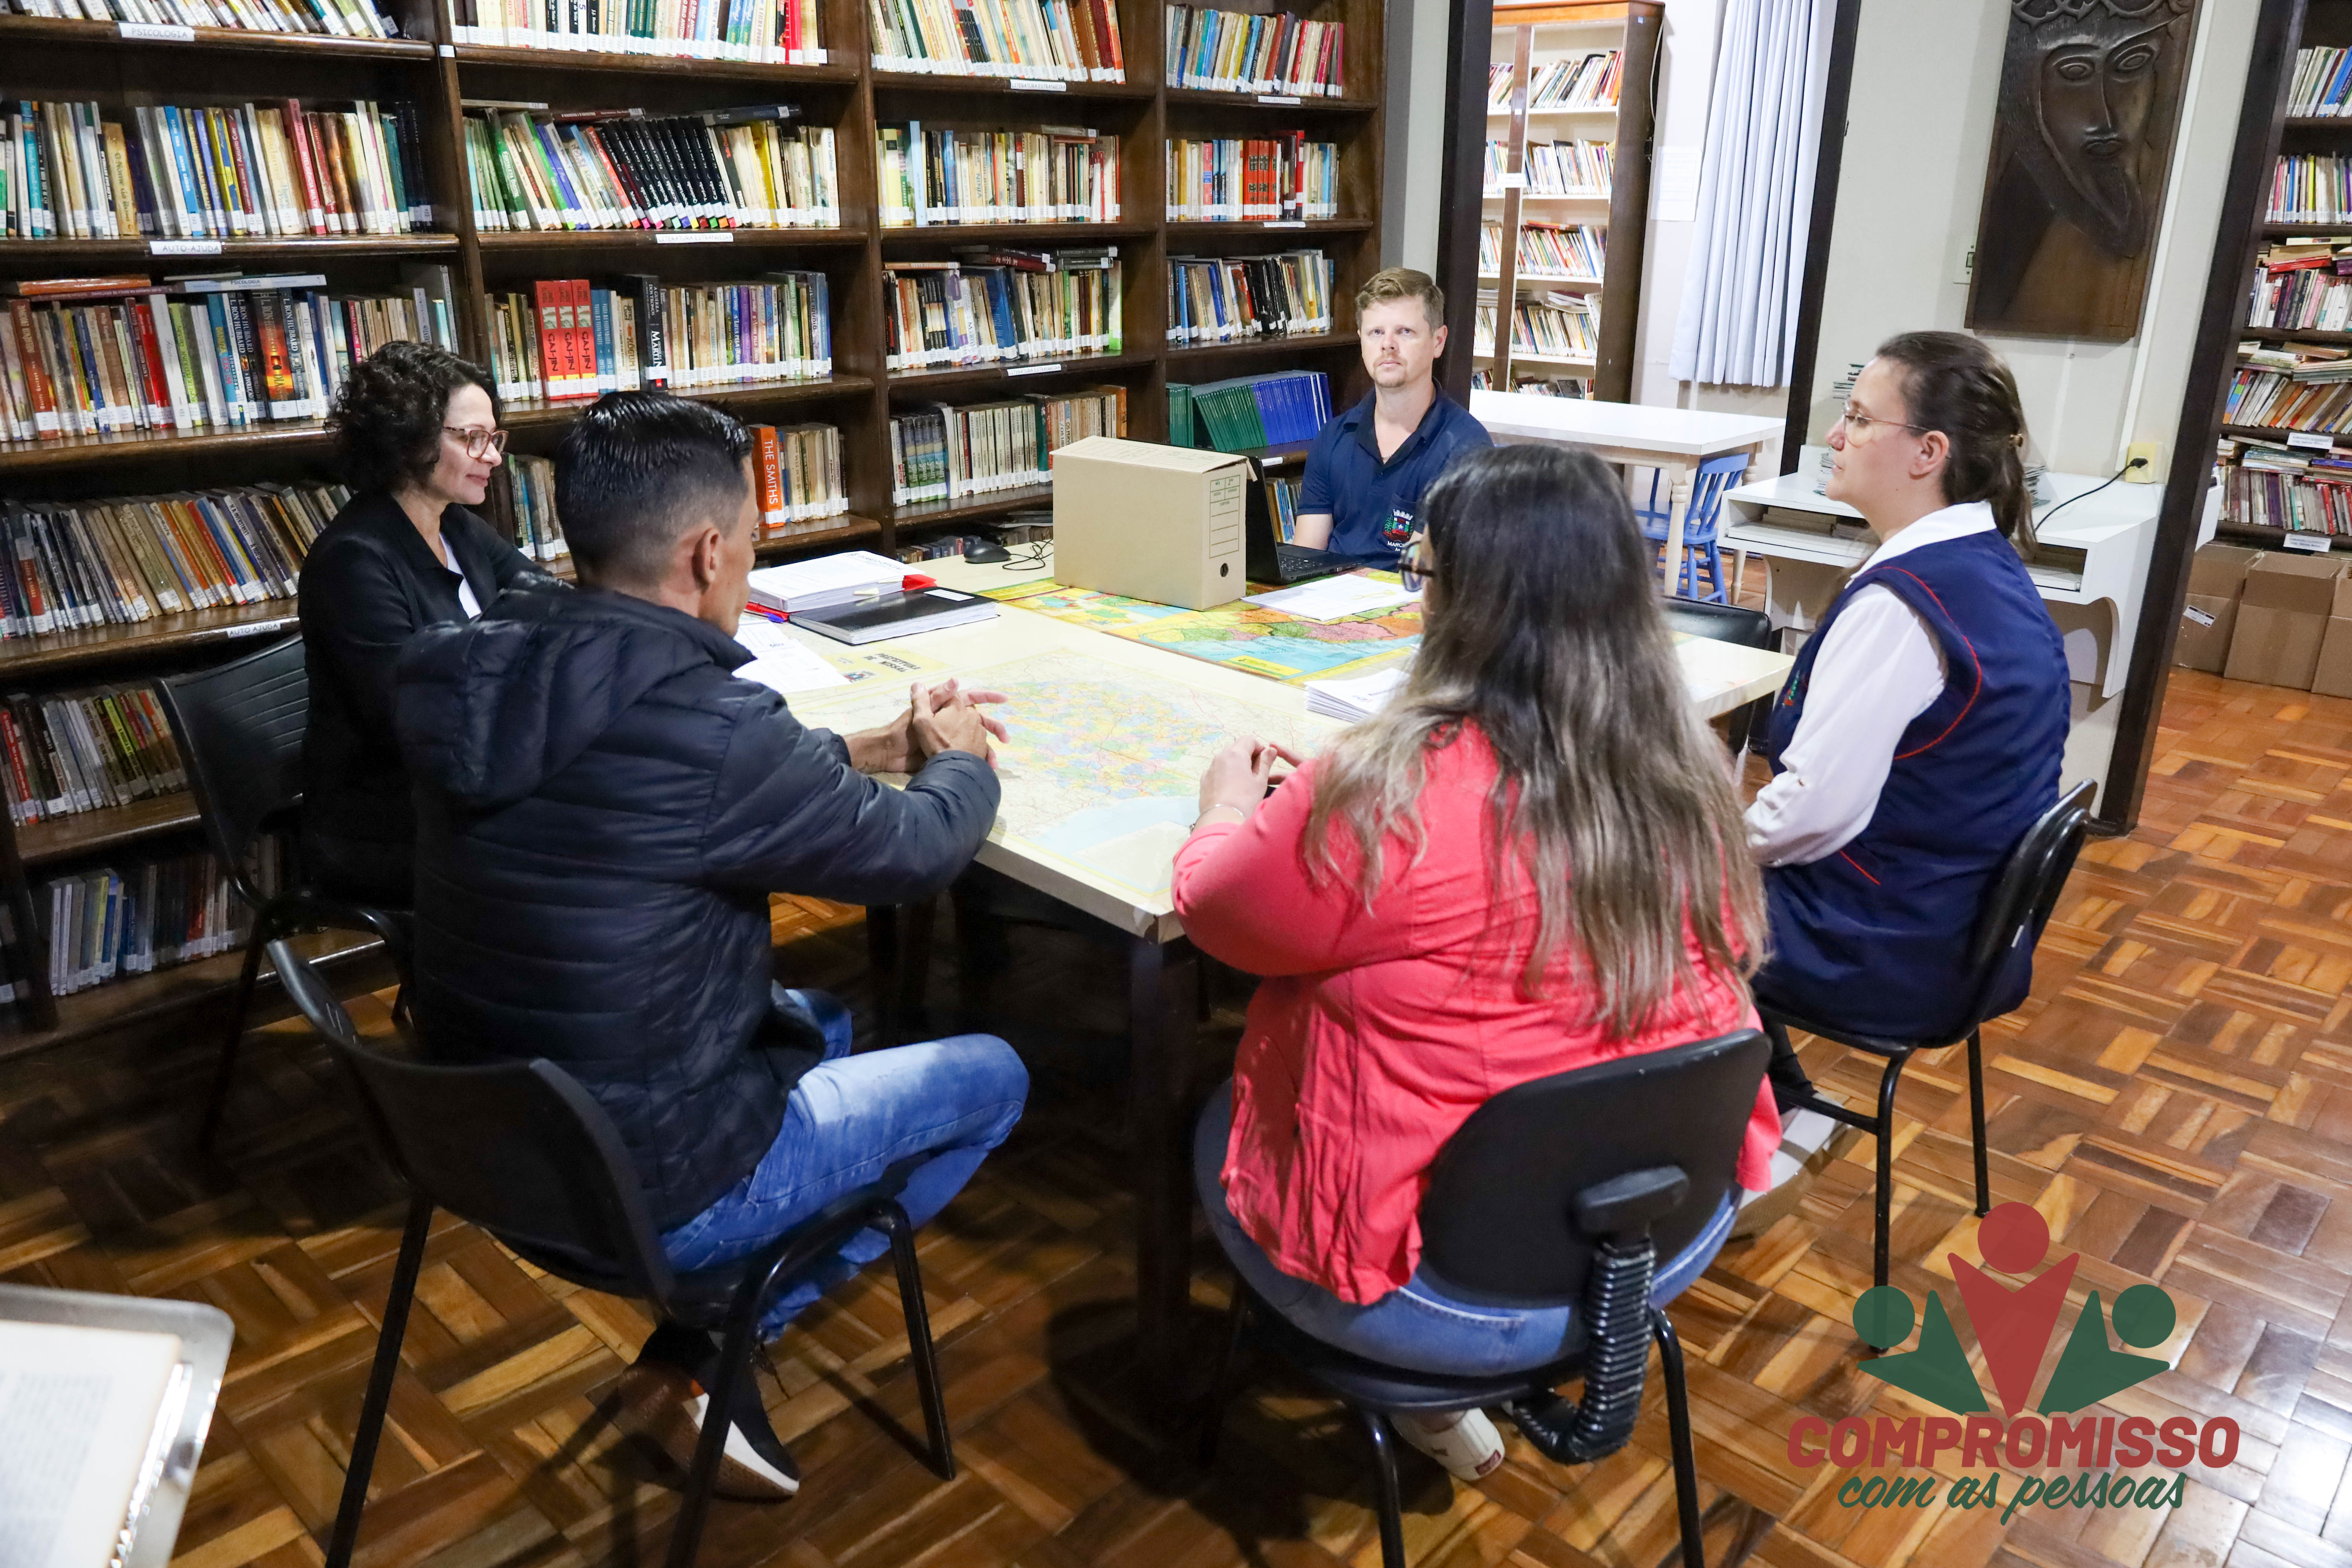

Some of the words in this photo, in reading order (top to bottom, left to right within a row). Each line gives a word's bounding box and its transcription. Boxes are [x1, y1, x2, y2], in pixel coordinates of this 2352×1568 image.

[132, 28, 187, 38] PSICOLOGIA
[115, 161, 124, 185] Nome
[303, 151, 315, 188] INTELIGÊNCIA
[502, 151, 515, 178] FORTALEZA
[510, 179, 519, 198] DIGITAL
[640, 187, 652, 208] Marcada
[657, 181, 669, 202] Revelada
[231, 306, 242, 319] RON
[240, 306, 249, 318] RON
[263, 306, 273, 320] RON
[285, 306, 294, 318] RON
[234, 320, 245, 353] HUBBARD
[242, 320, 253, 352] HUBBARD
[287, 320, 298, 351] HUBBARD
[548, 334, 558, 371] GAI-JIN
[565, 332, 574, 370] GAI-JIN
[582, 332, 591, 369] GAI-JIN
[651, 331, 662, 367] MARTIN
[245, 377, 254, 398] EVOLUÇÃO
[1060, 427, 1064, 436] OS
[764, 439, 774, 460] THE
[766, 464, 779, 504] SMITHS
[234, 512, 249, 536] OVERSTREET
[229, 627, 251, 637] AUTO
[254, 623, 279, 634] AJUDA
